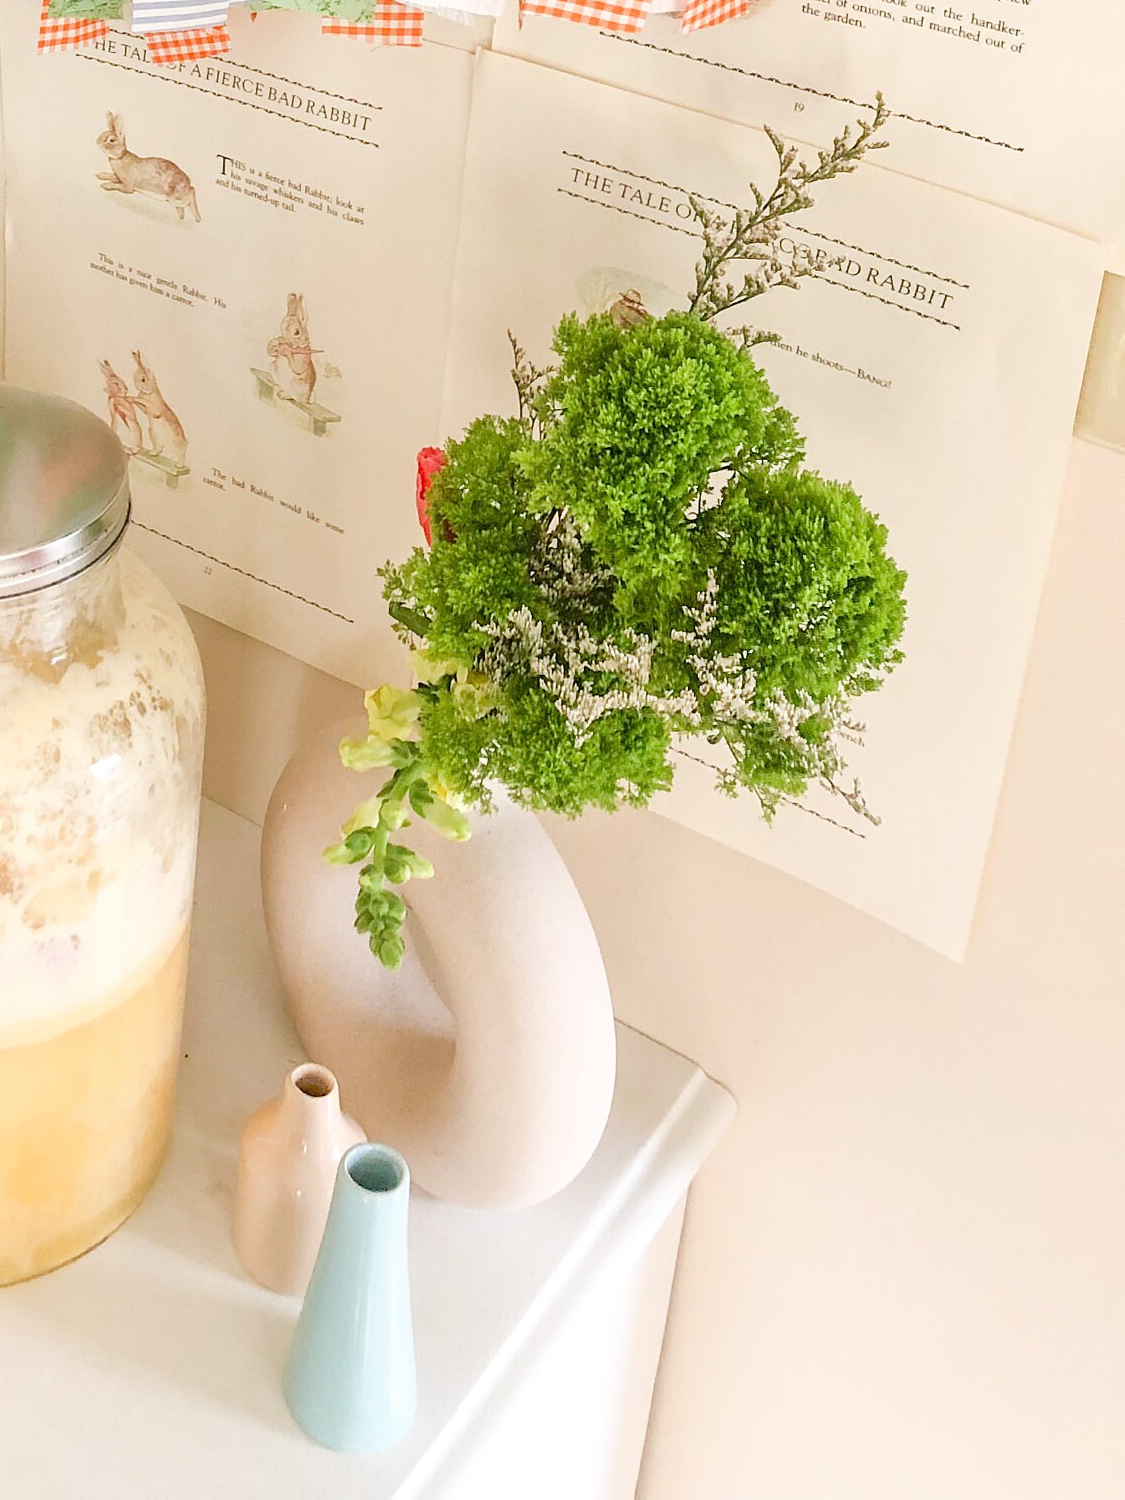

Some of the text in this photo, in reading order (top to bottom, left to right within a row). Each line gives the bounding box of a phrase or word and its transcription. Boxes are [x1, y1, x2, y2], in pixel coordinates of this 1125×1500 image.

[915, 3, 935, 14] out
[943, 6, 963, 21] the
[970, 12, 1024, 36] handker-
[93, 38, 117, 54] HE
[120, 43, 151, 64] TAL
[190, 63, 202, 78] A
[205, 66, 264, 97] FIERCE
[267, 86, 302, 109] BAD
[305, 99, 371, 130] RABBIT
[793, 101, 805, 112] 19
[570, 167, 614, 194] THE
[618, 182, 671, 213] TALE
[865, 267, 954, 309] RABBIT
[795, 344, 809, 358] he
